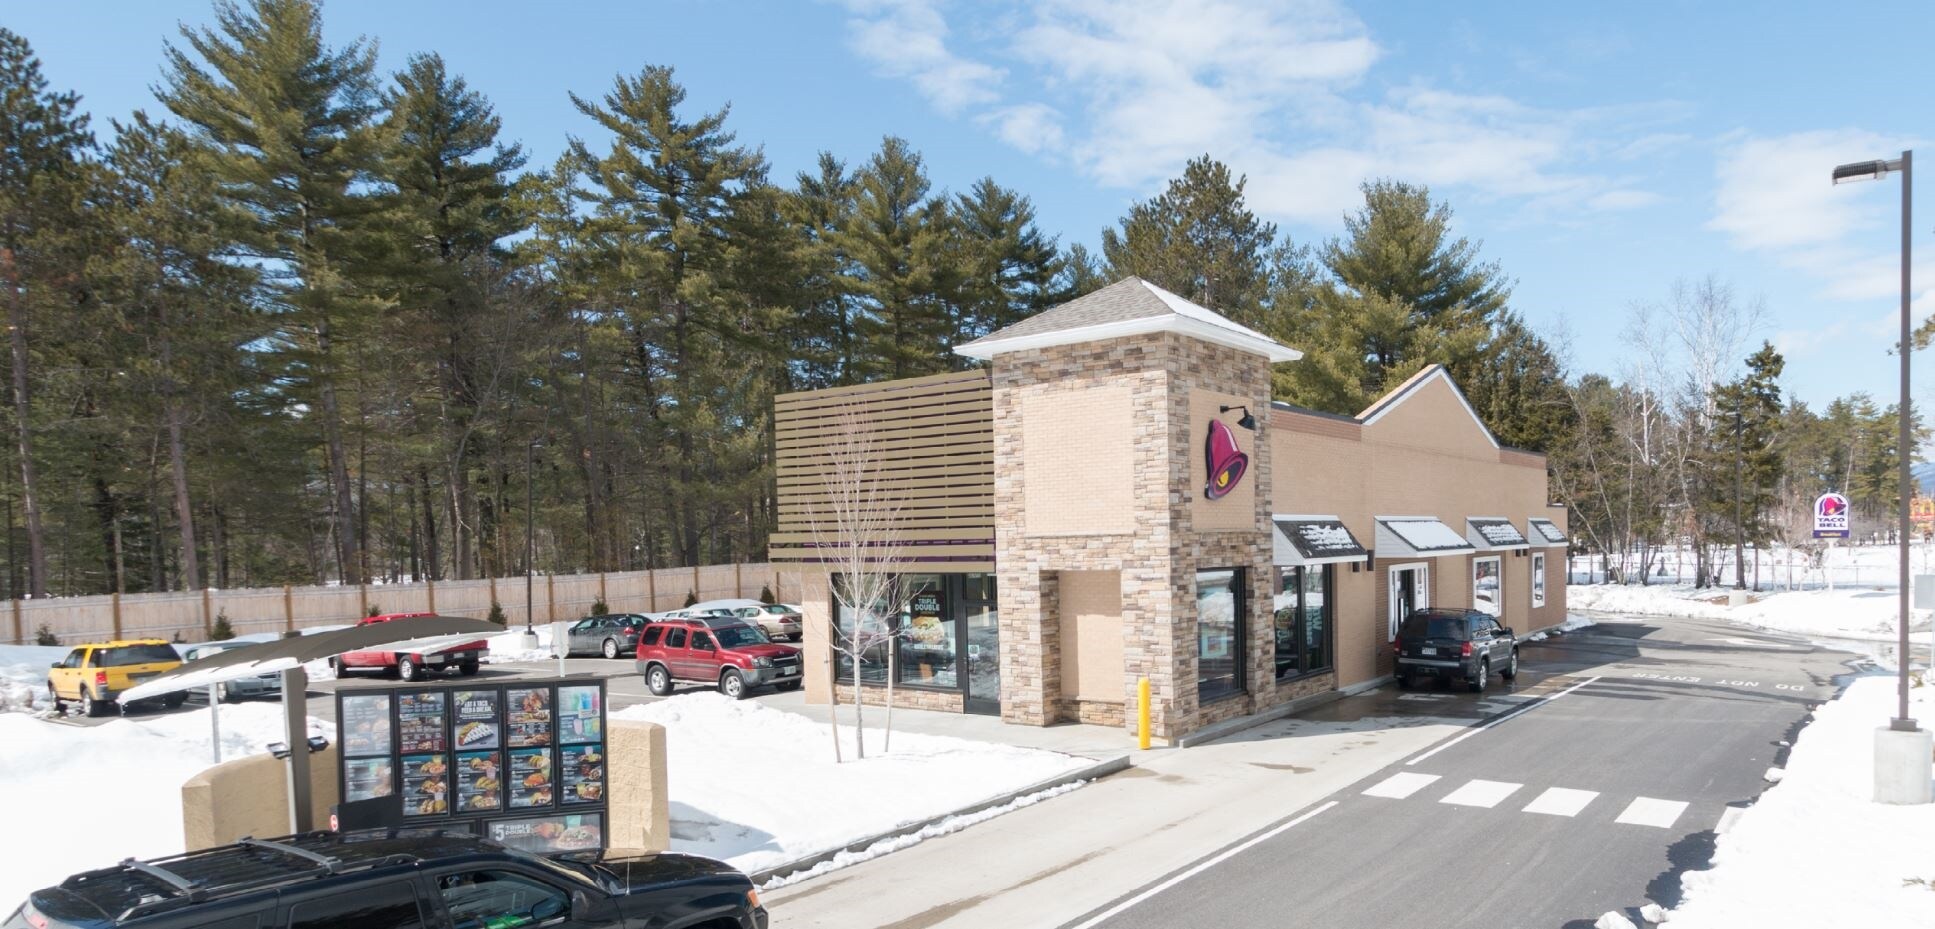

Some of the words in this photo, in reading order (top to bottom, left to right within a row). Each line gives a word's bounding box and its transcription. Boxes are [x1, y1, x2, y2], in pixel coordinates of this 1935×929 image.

[1312, 608, 1322, 630] OW
[1632, 672, 1702, 683] ENTER
[1715, 679, 1760, 688] NOT
[1775, 683, 1805, 692] DO
